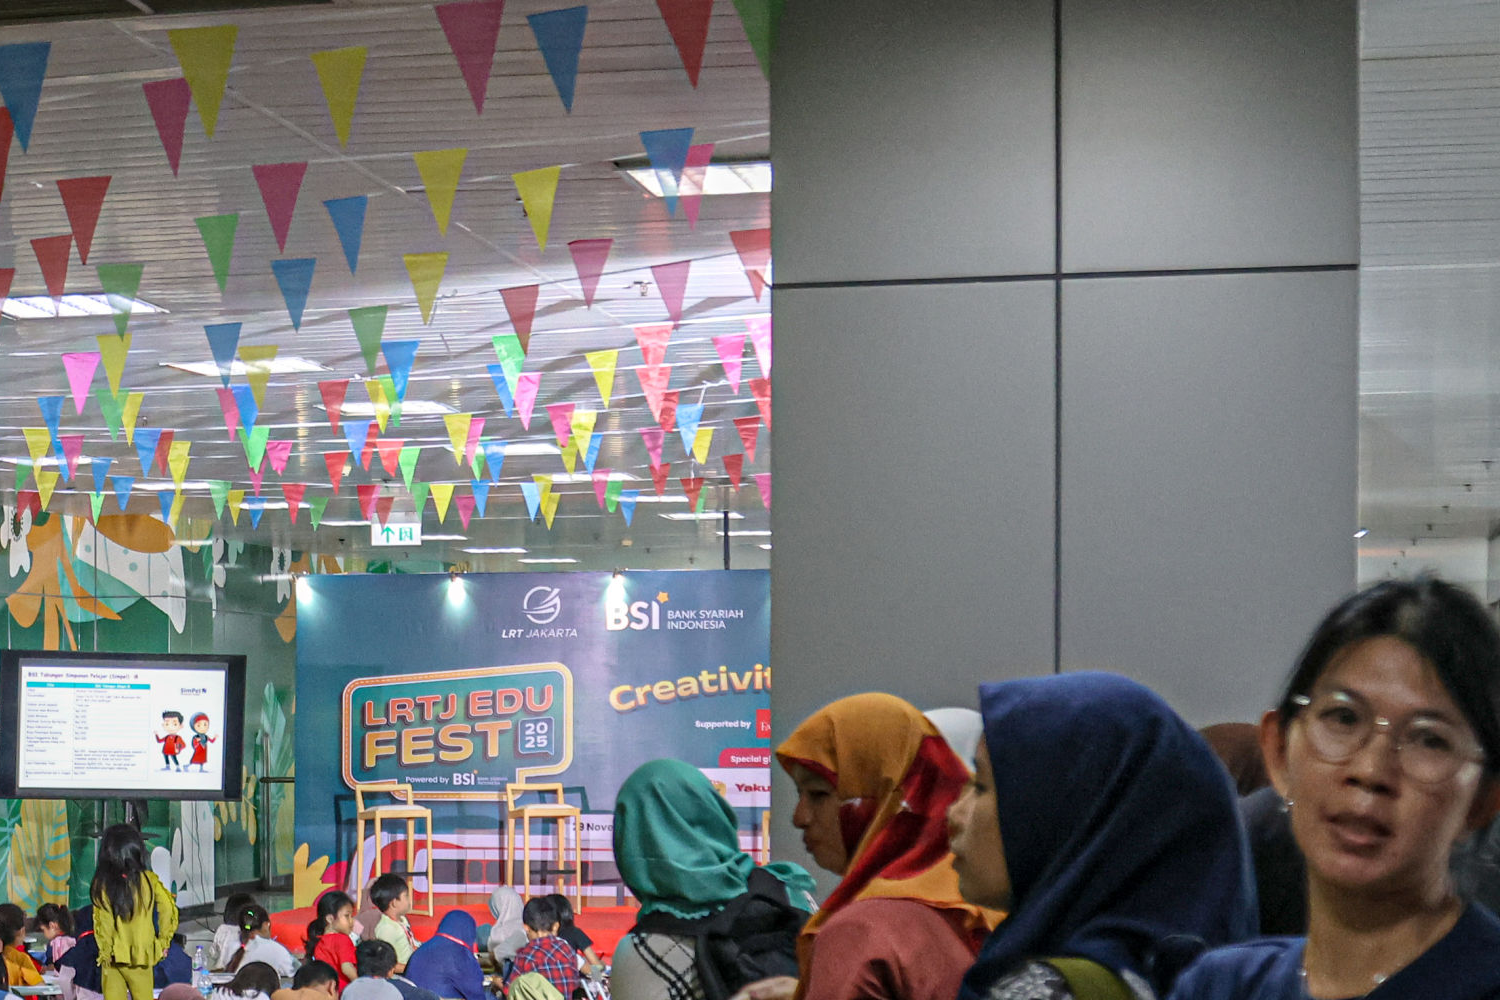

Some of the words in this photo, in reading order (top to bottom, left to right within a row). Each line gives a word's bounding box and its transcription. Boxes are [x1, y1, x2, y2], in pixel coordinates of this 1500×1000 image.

[604, 599, 660, 631] BSI
[667, 609, 697, 619] BANK
[699, 609, 744, 619] SYARIAH
[667, 620, 727, 630] INDONESIA
[501, 628, 525, 639] LRT
[525, 628, 579, 639] JAKARTA
[365, 693, 457, 726] LRTJ
[469, 685, 553, 717] EDU
[524, 721, 549, 735] 20
[695, 719, 739, 730] Supported
[740, 720, 752, 730] by
[365, 720, 512, 768] FEST
[524, 735, 549, 748] 25
[730, 755, 762, 765] Special
[405, 775, 438, 784] Powered
[439, 775, 450, 785] by
[453, 772, 475, 786] BSI
